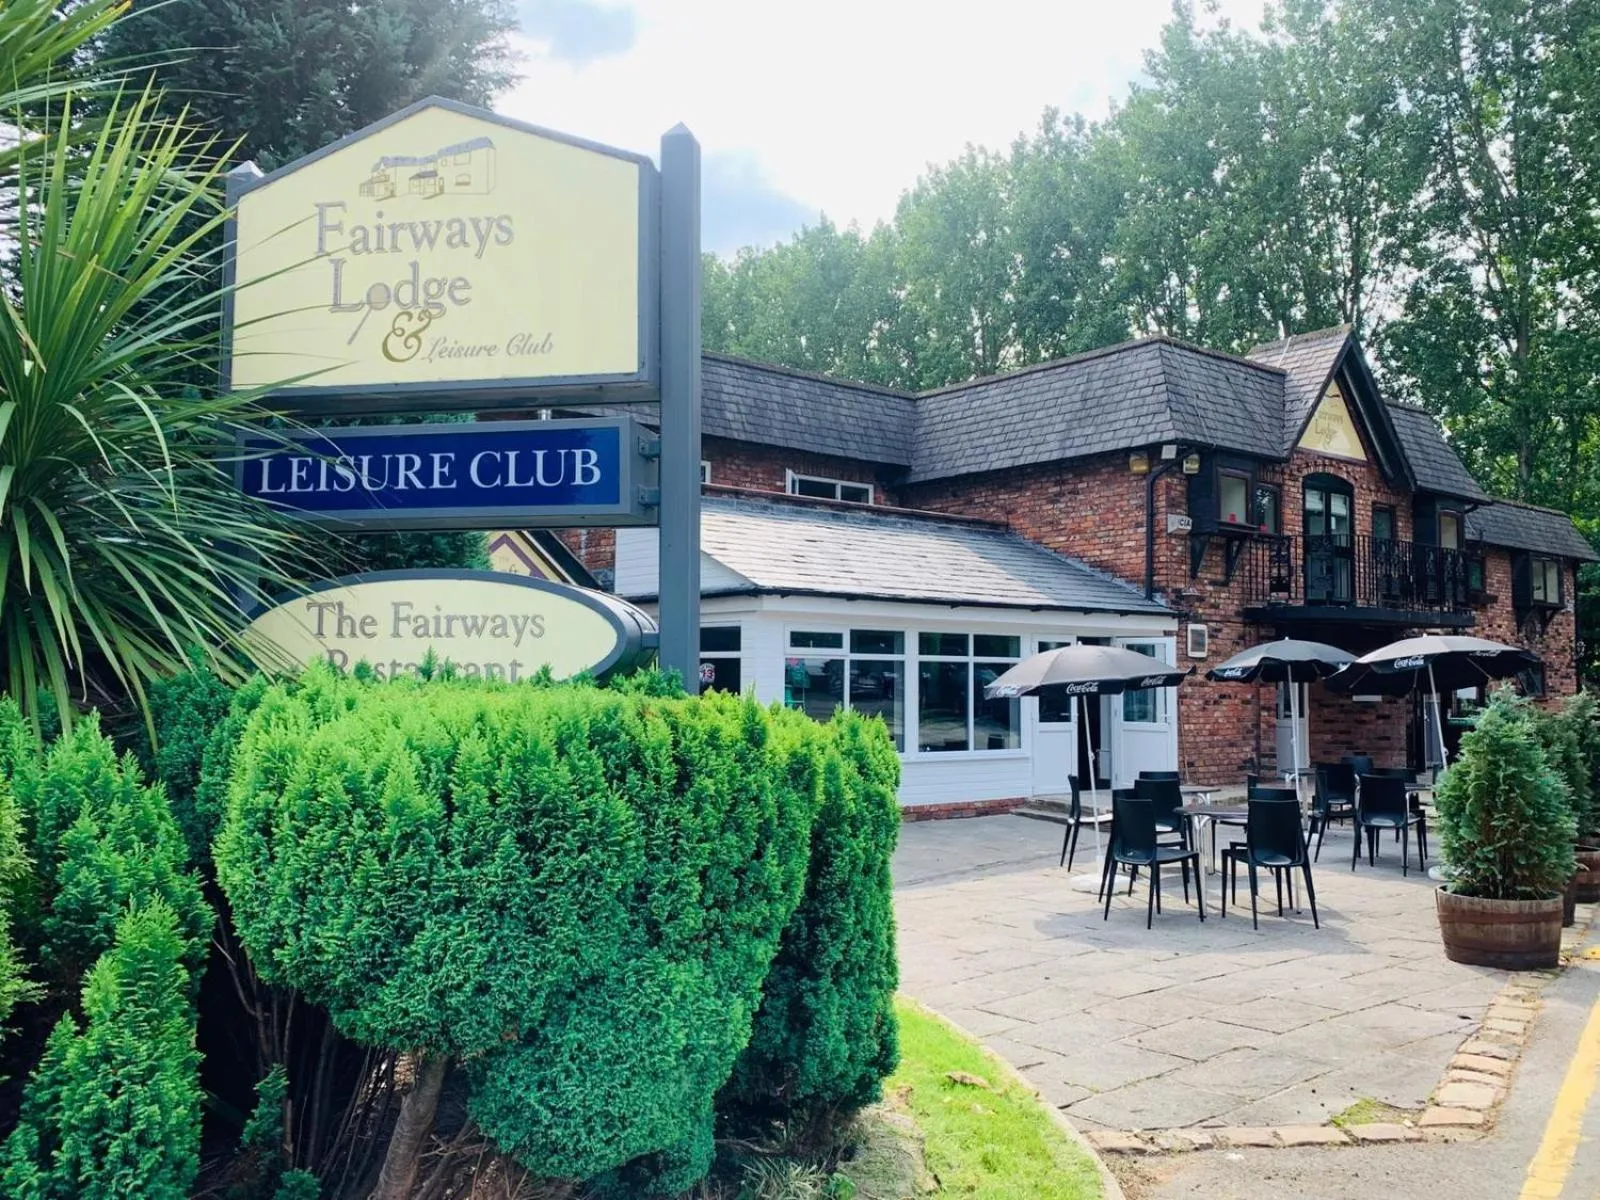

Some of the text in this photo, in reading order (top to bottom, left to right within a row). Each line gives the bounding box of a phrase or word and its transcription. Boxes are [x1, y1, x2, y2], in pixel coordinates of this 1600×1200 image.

[314, 201, 514, 259] Fairways
[328, 258, 472, 319] Lodge
[382, 311, 553, 364] & Leisure Club
[258, 448, 602, 493] LEISURE CLUB
[306, 600, 546, 648] The Fairways
